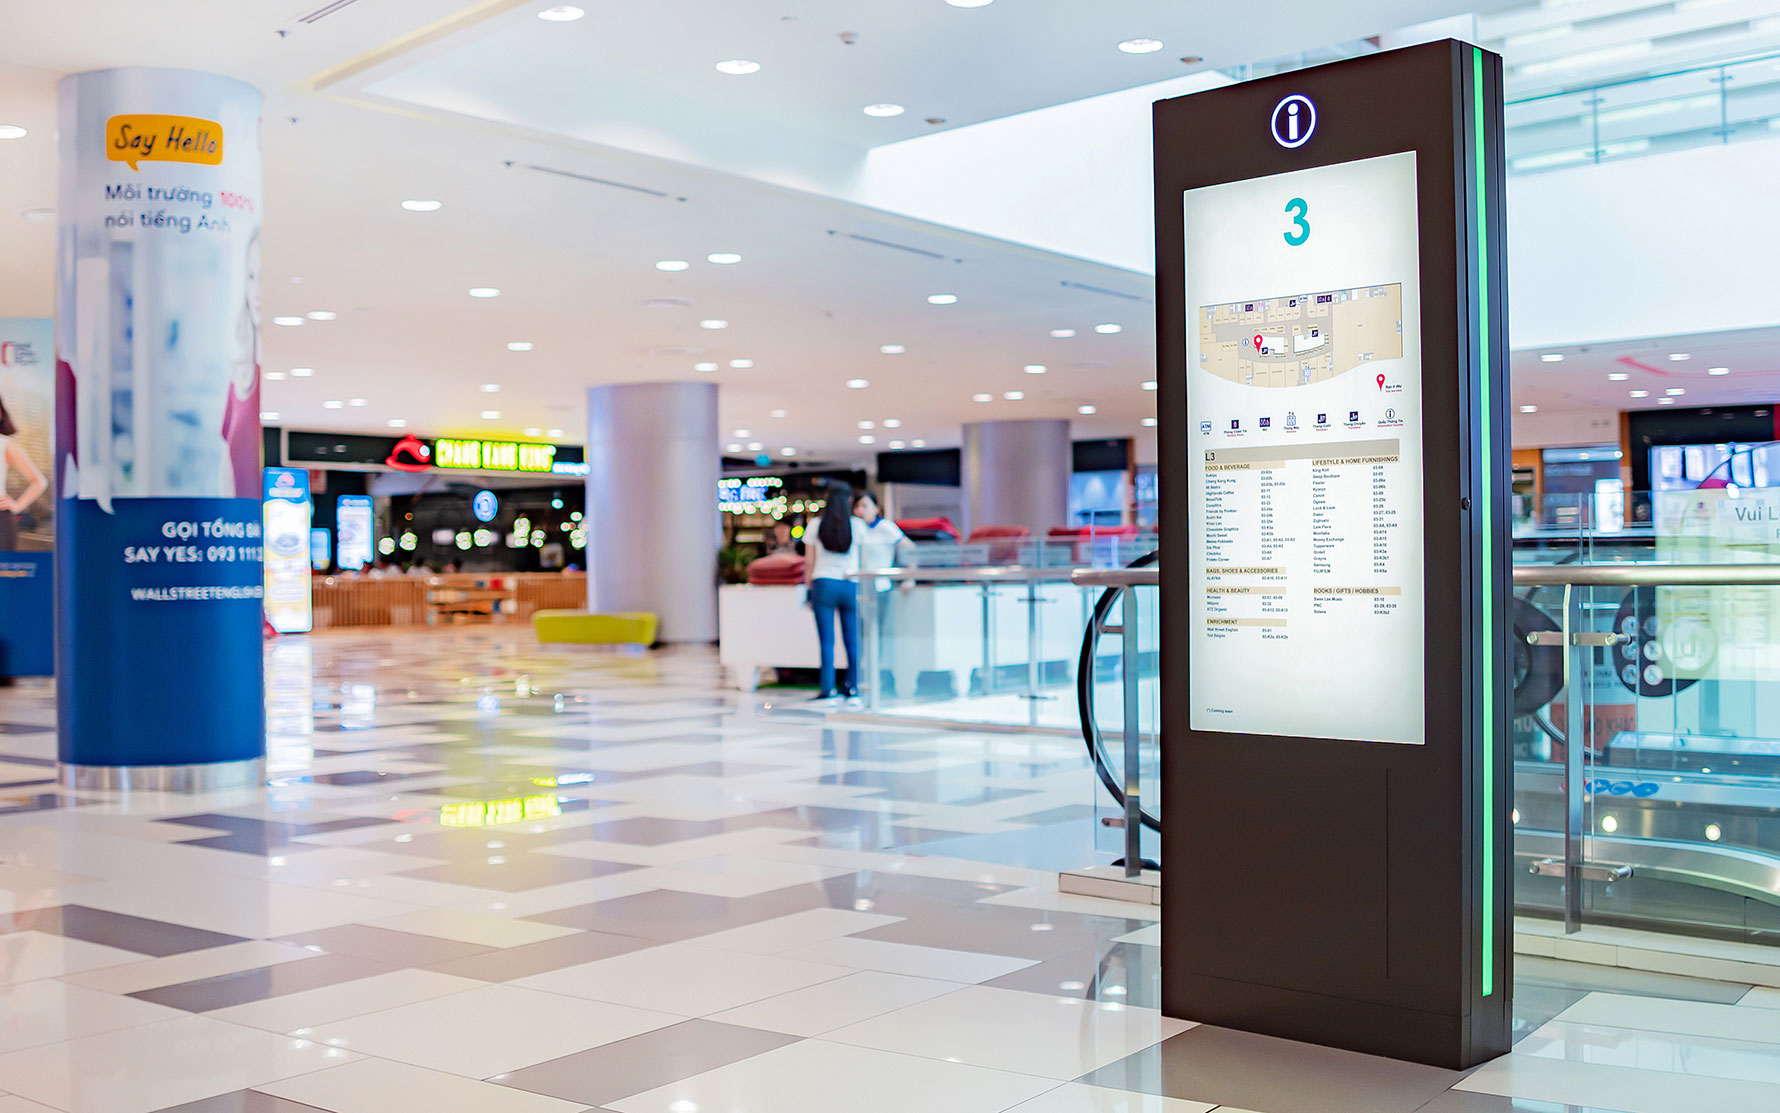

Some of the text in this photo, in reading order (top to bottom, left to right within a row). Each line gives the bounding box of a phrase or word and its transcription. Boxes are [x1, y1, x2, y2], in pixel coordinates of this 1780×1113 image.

[115, 124, 217, 156] Say Hello
[1284, 198, 1310, 246] 3
[1205, 453, 1215, 461] L3
[1735, 506, 1780, 521] Vui L
[162, 522, 198, 541] GỌI
[124, 546, 160, 563] SAY
[163, 546, 203, 562] YES:
[207, 546, 235, 562] 093
